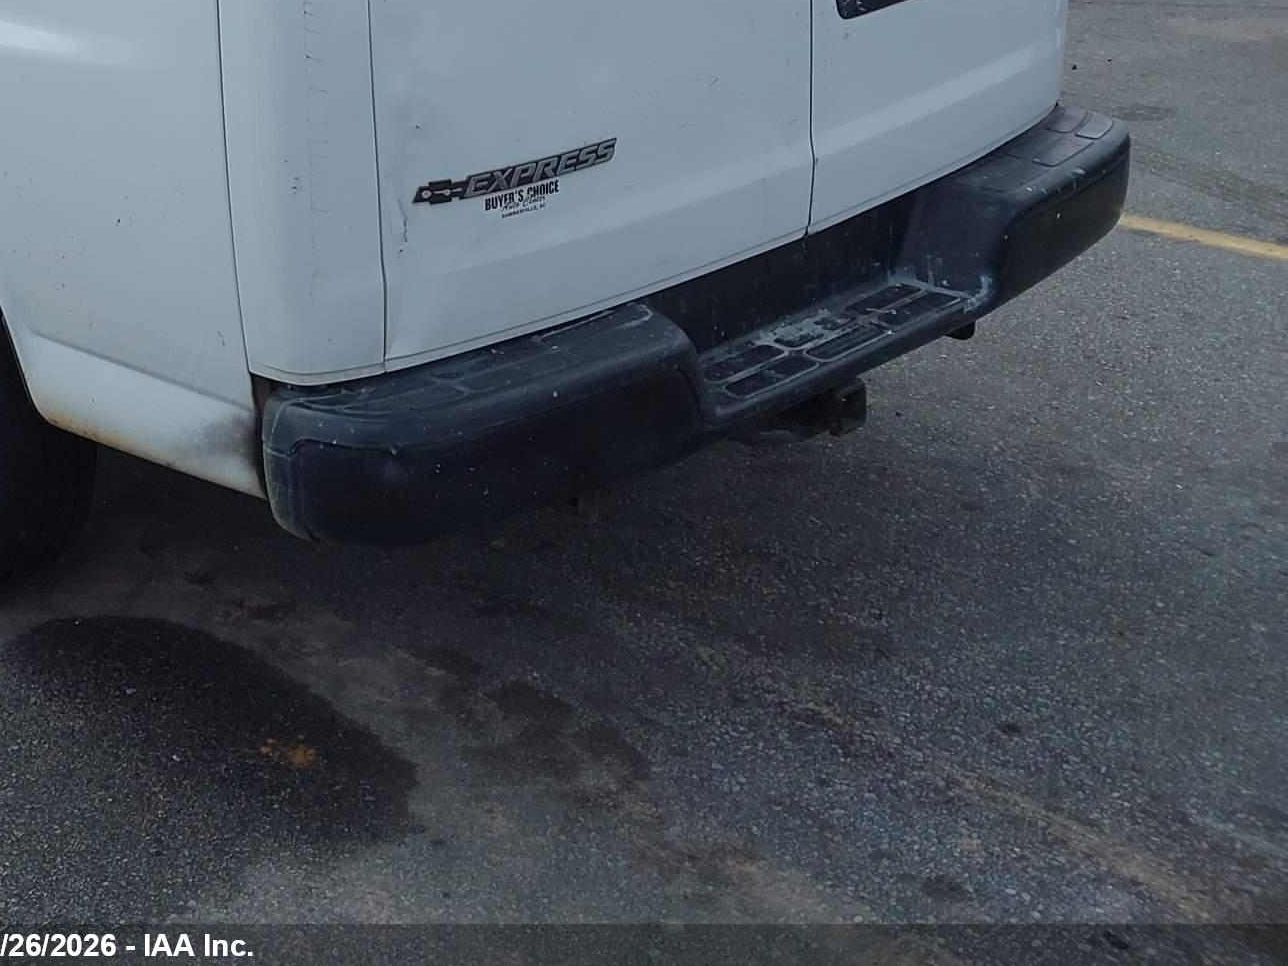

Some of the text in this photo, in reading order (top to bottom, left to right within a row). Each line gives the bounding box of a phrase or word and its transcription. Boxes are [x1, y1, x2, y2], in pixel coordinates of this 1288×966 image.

[464, 138, 617, 198] EXPRESS
[484, 179, 560, 211] BUYER'S CHOICE
